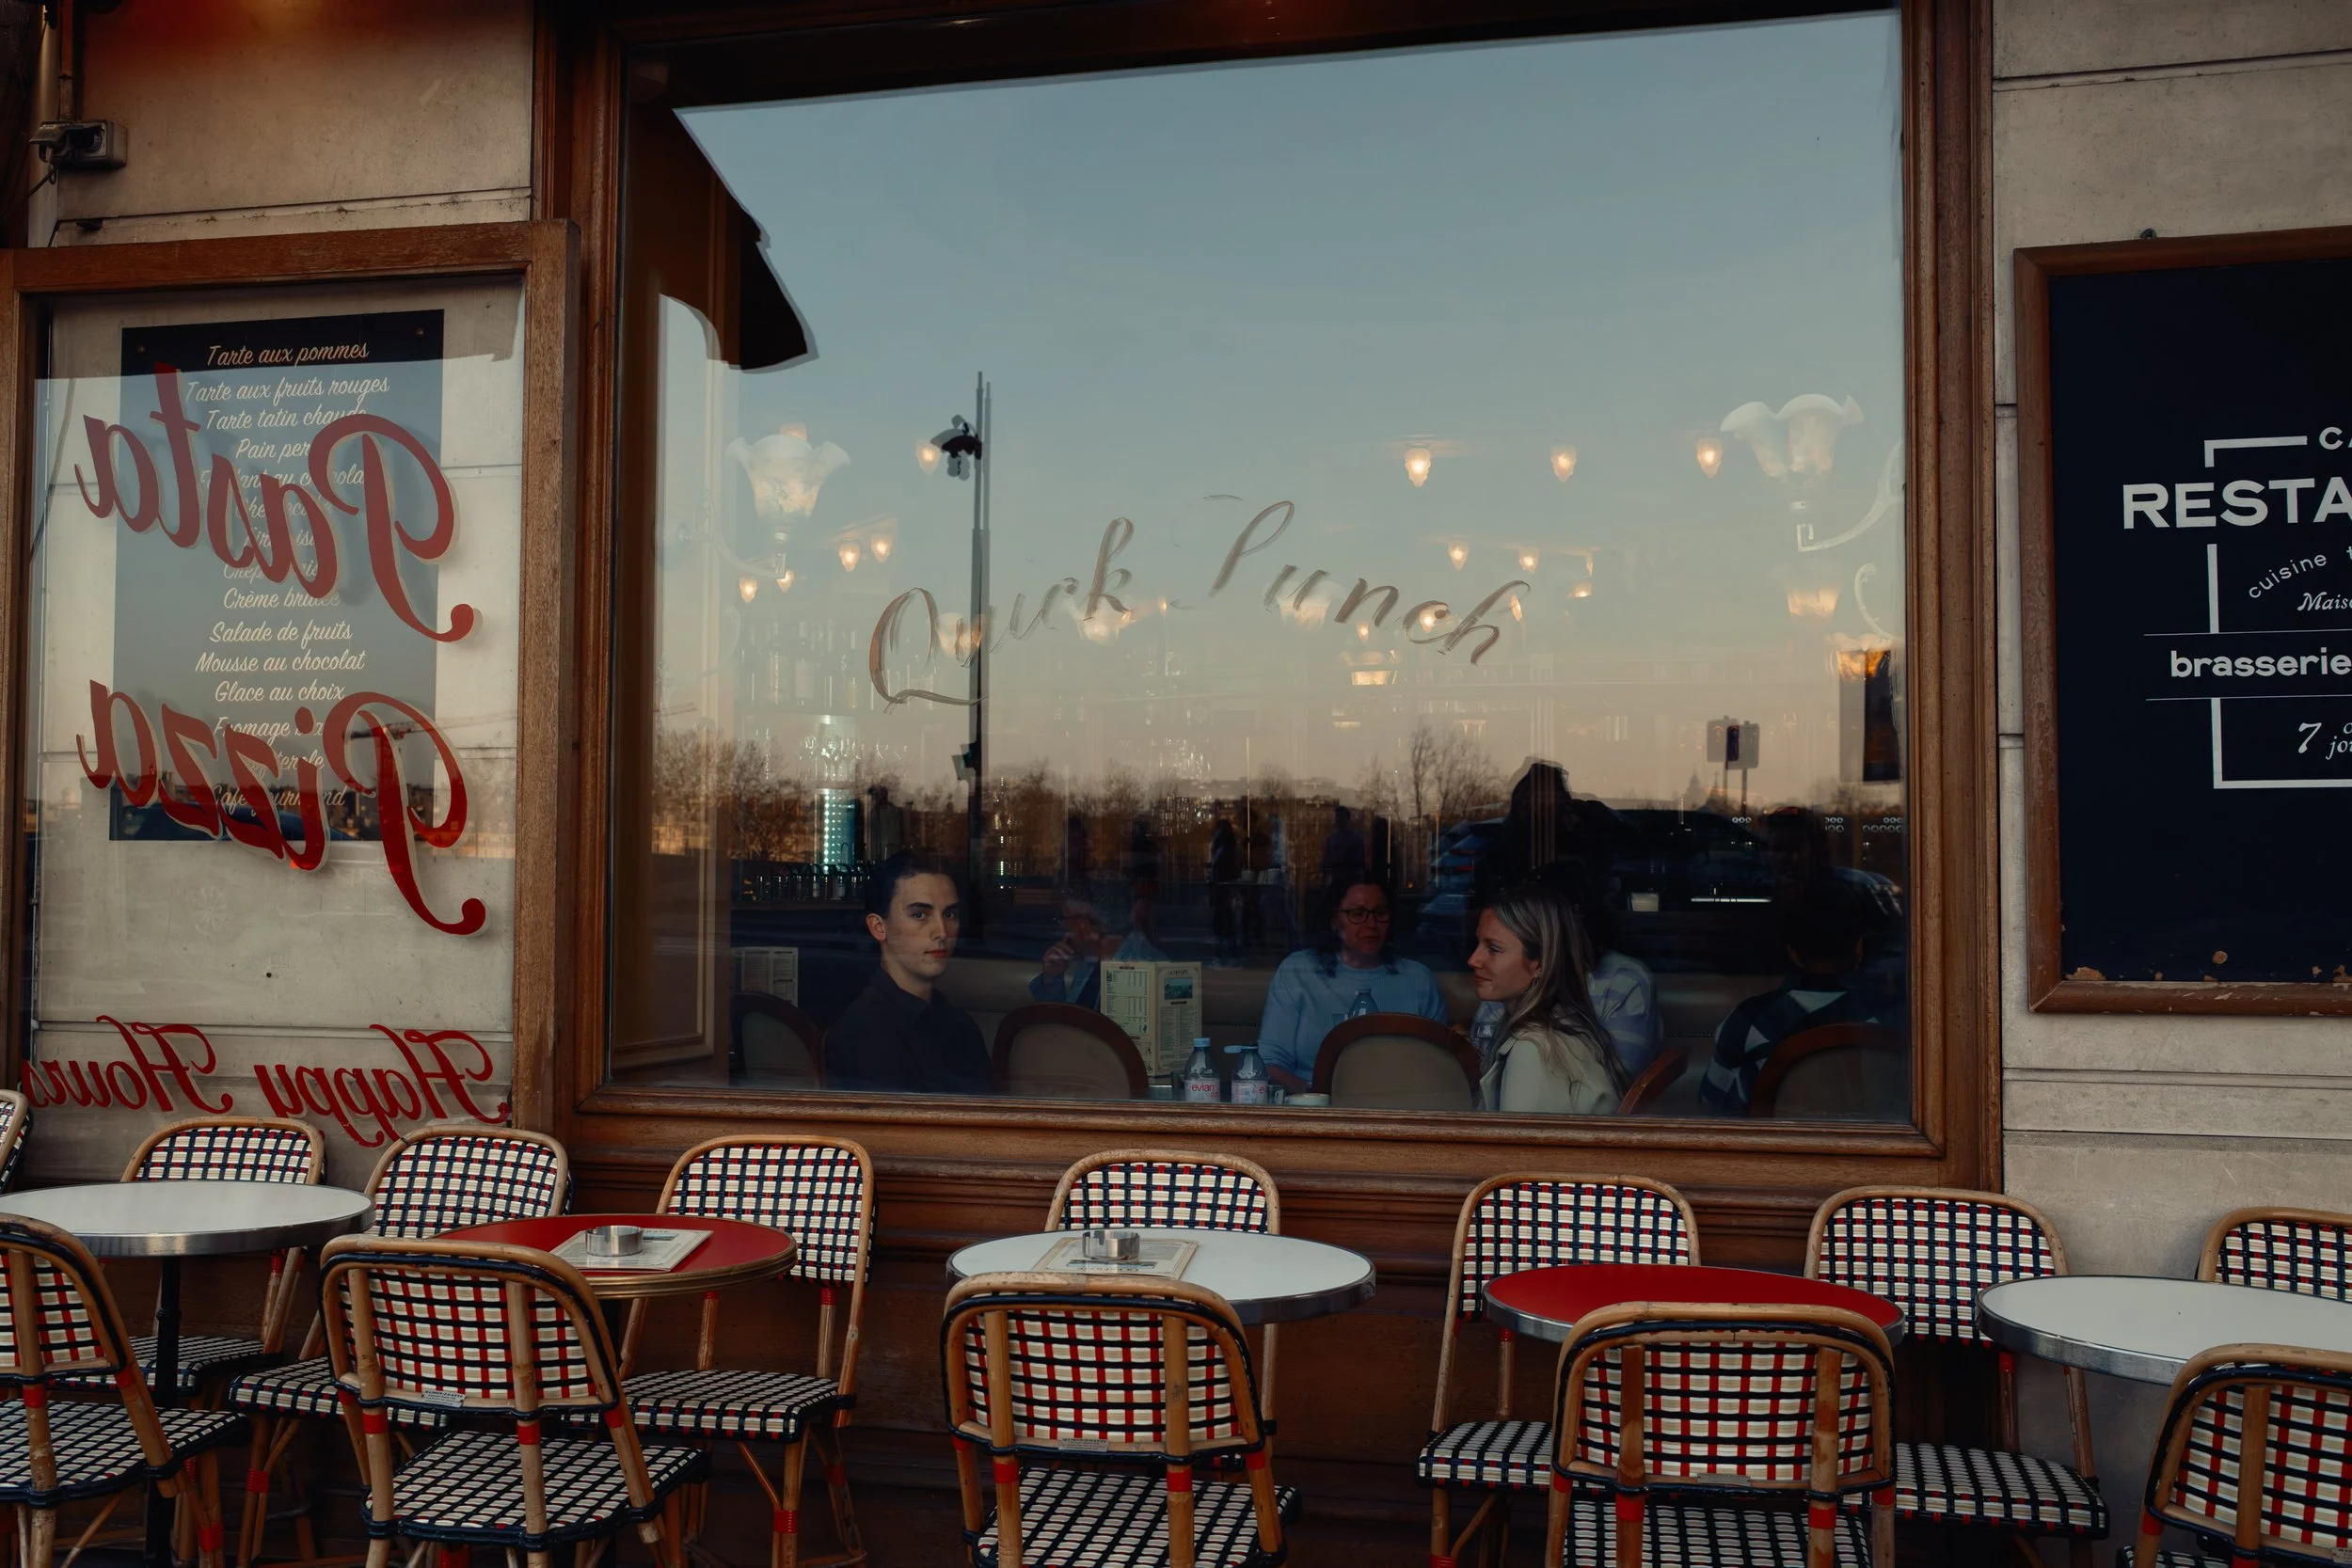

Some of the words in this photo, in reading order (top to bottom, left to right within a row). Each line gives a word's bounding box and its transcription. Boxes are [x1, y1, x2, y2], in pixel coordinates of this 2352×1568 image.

[207, 345, 254, 366] Tarte
[259, 348, 294, 364] aux
[294, 342, 370, 368] pommes
[186, 381, 232, 402] Tarte
[237, 383, 271, 400] aux
[273, 376, 325, 406] fruits
[327, 377, 390, 404] rouges
[206, 409, 252, 430] Tarte
[257, 407, 297, 428] tatin
[303, 402, 367, 425] chaud
[235, 438, 277, 459] Pain
[278, 441, 310, 464] per
[2319, 426, 2352, 450] C
[2249, 554, 2327, 598] cuisine
[224, 588, 279, 609] Crème
[209, 620, 272, 642] Salade
[277, 620, 299, 641] de
[301, 619, 353, 649] fruits
[196, 651, 259, 673] Mousse
[263, 657, 287, 671] au
[292, 649, 366, 670] chocolat
[2171, 647, 2351, 677] brasserie
[215, 681, 264, 702] Glace
[269, 687, 293, 701] au
[298, 678, 345, 700] choix
[2298, 722, 2322, 753] 7
[2326, 736, 2352, 760] jo
[1191, 1084, 1215, 1092] evian
